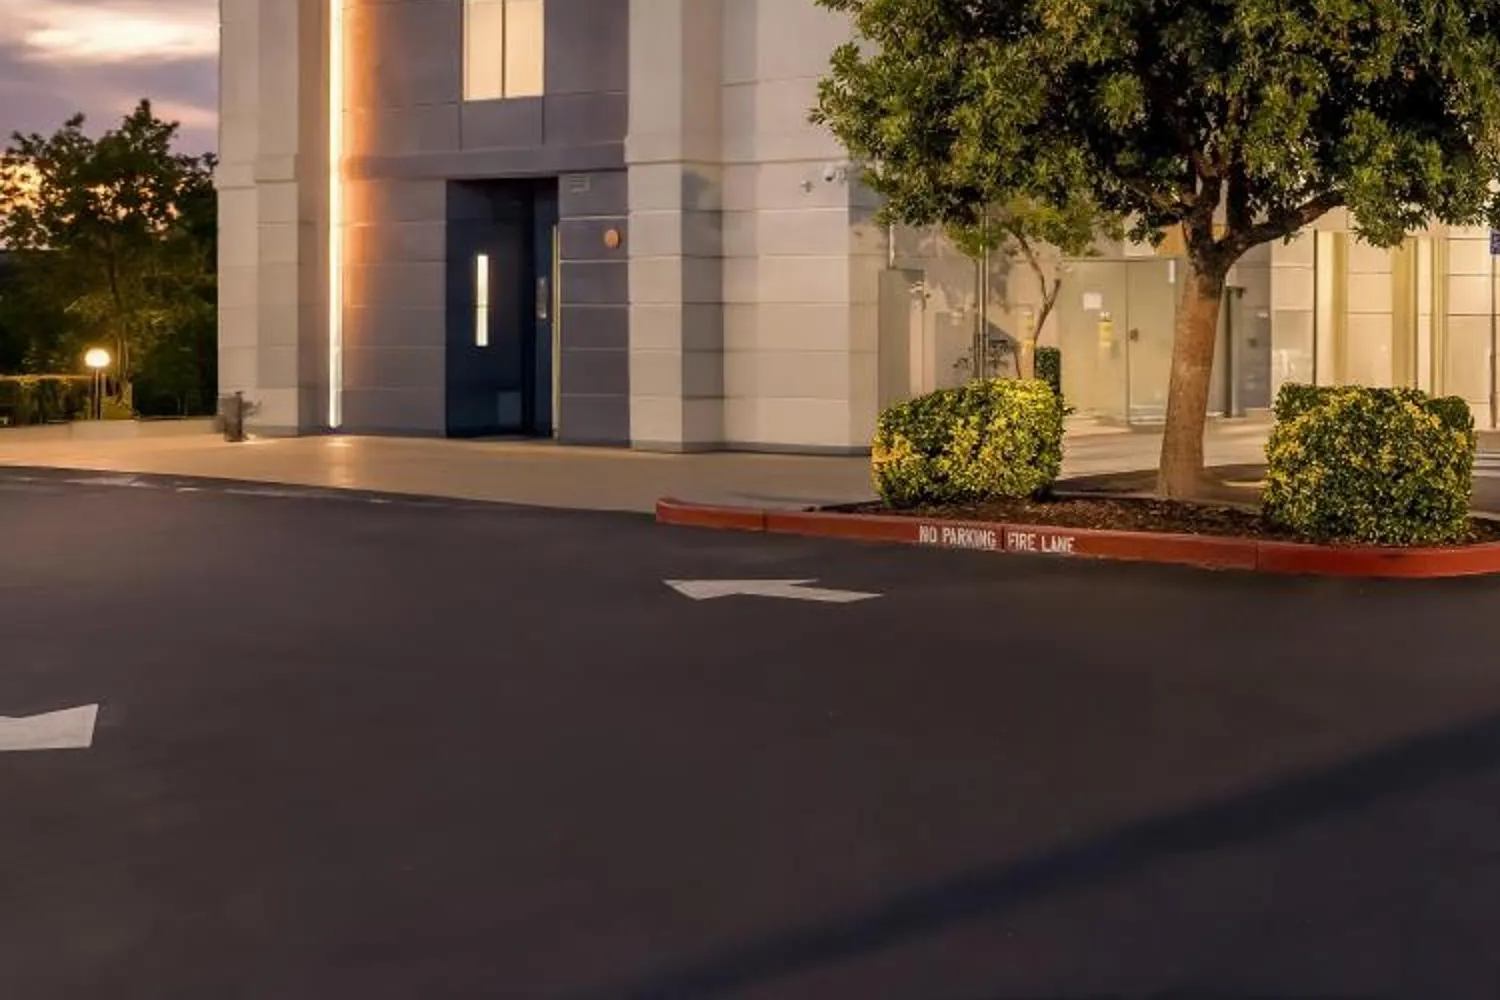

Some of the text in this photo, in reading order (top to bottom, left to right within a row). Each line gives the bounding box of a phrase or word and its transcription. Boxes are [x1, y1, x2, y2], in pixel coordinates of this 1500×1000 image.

[919, 525, 1076, 553] NO PARKING FIRE LANE
